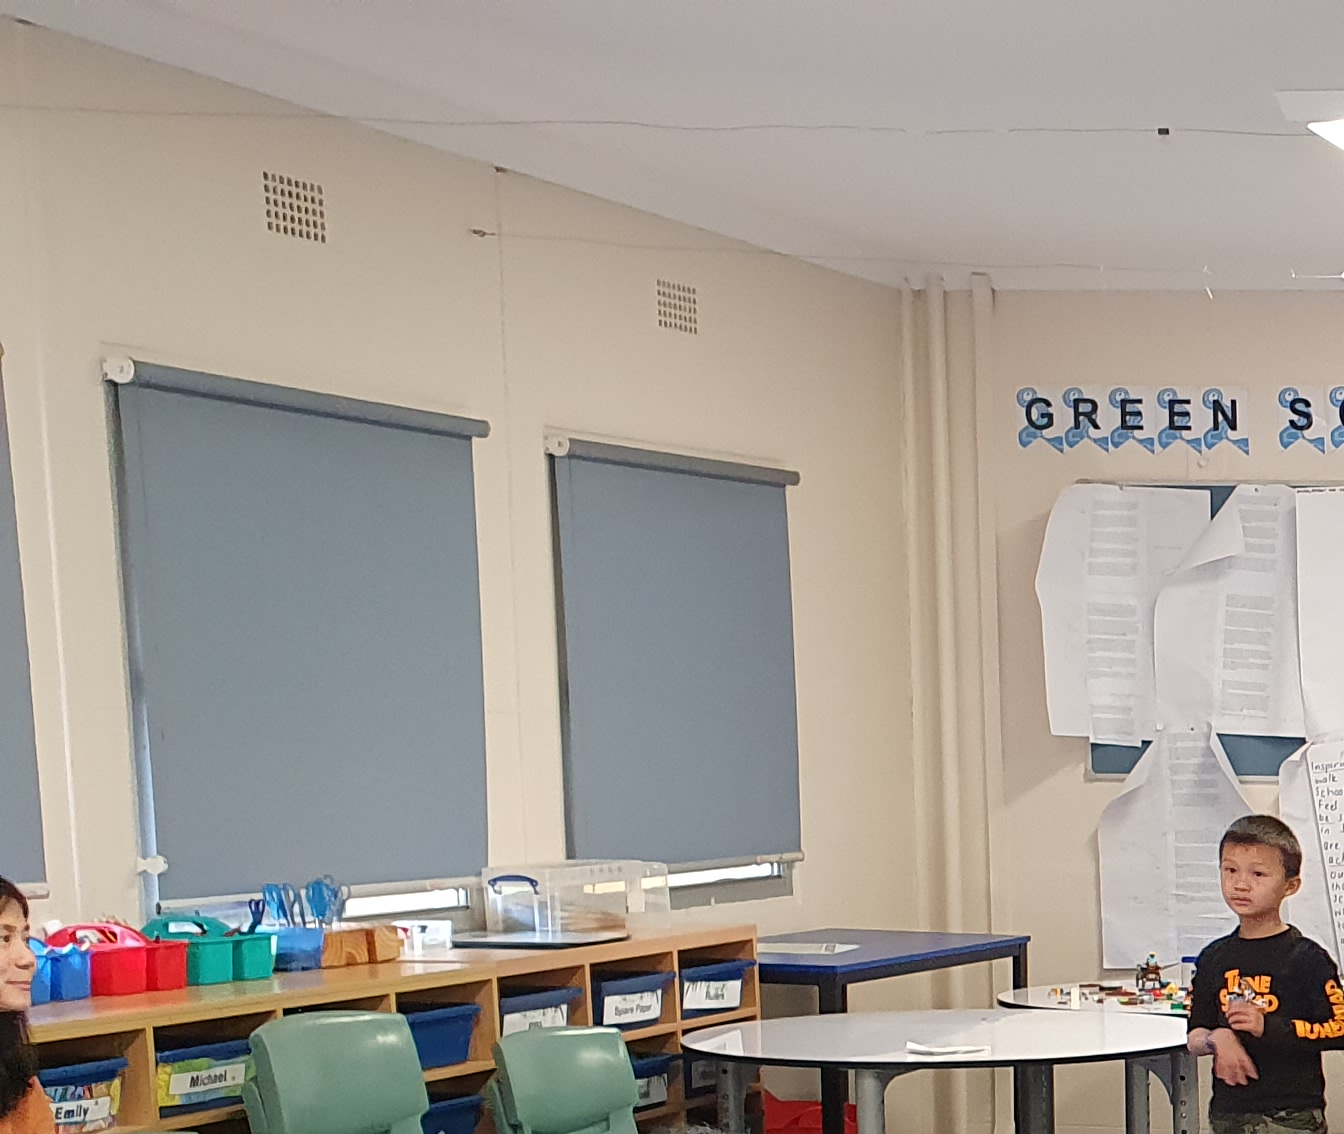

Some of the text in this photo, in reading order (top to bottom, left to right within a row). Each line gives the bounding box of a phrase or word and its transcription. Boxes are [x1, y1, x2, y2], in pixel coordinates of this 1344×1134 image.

[1024, 396, 1238, 431] GREEN
[1224, 969, 1271, 993] TNE
[614, 1006, 634, 1015] Spare
[189, 1071, 228, 1088] Michael
[55, 1106, 89, 1120] Emily
